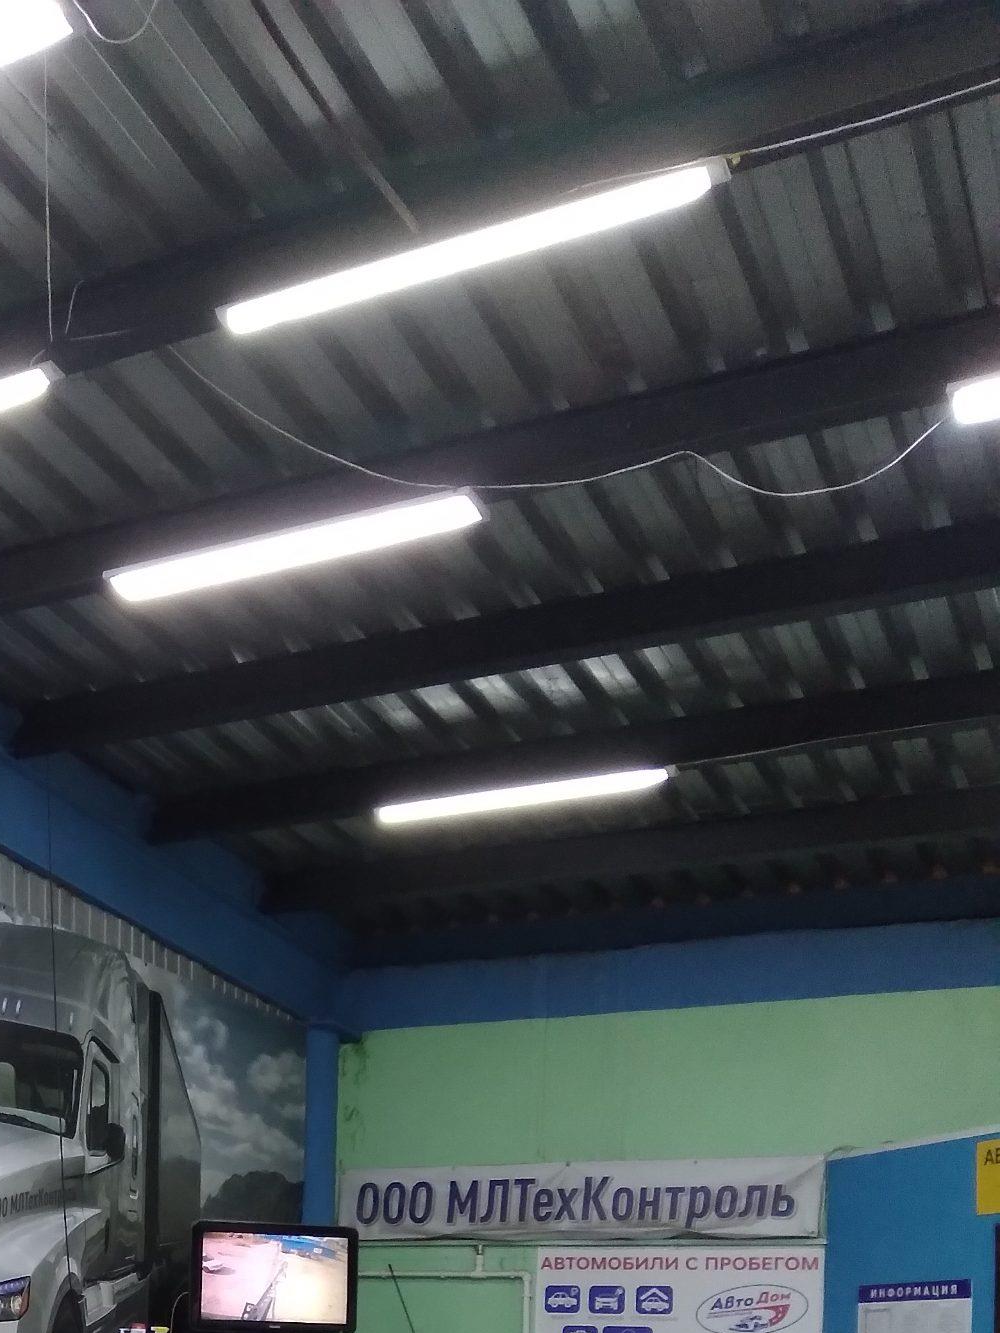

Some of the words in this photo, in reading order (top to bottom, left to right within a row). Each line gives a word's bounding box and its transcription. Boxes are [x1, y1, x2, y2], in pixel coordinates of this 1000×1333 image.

[356, 1181, 433, 1225] ООО
[446, 1176, 796, 1229] МЛТехКонтроль
[540, 1256, 679, 1271] АВТОМОБИЛИ
[685, 1257, 698, 1271] С
[705, 1256, 819, 1271] ПРОБЕГОМ
[869, 1284, 958, 1299] ИНФОРМАЦИЯ
